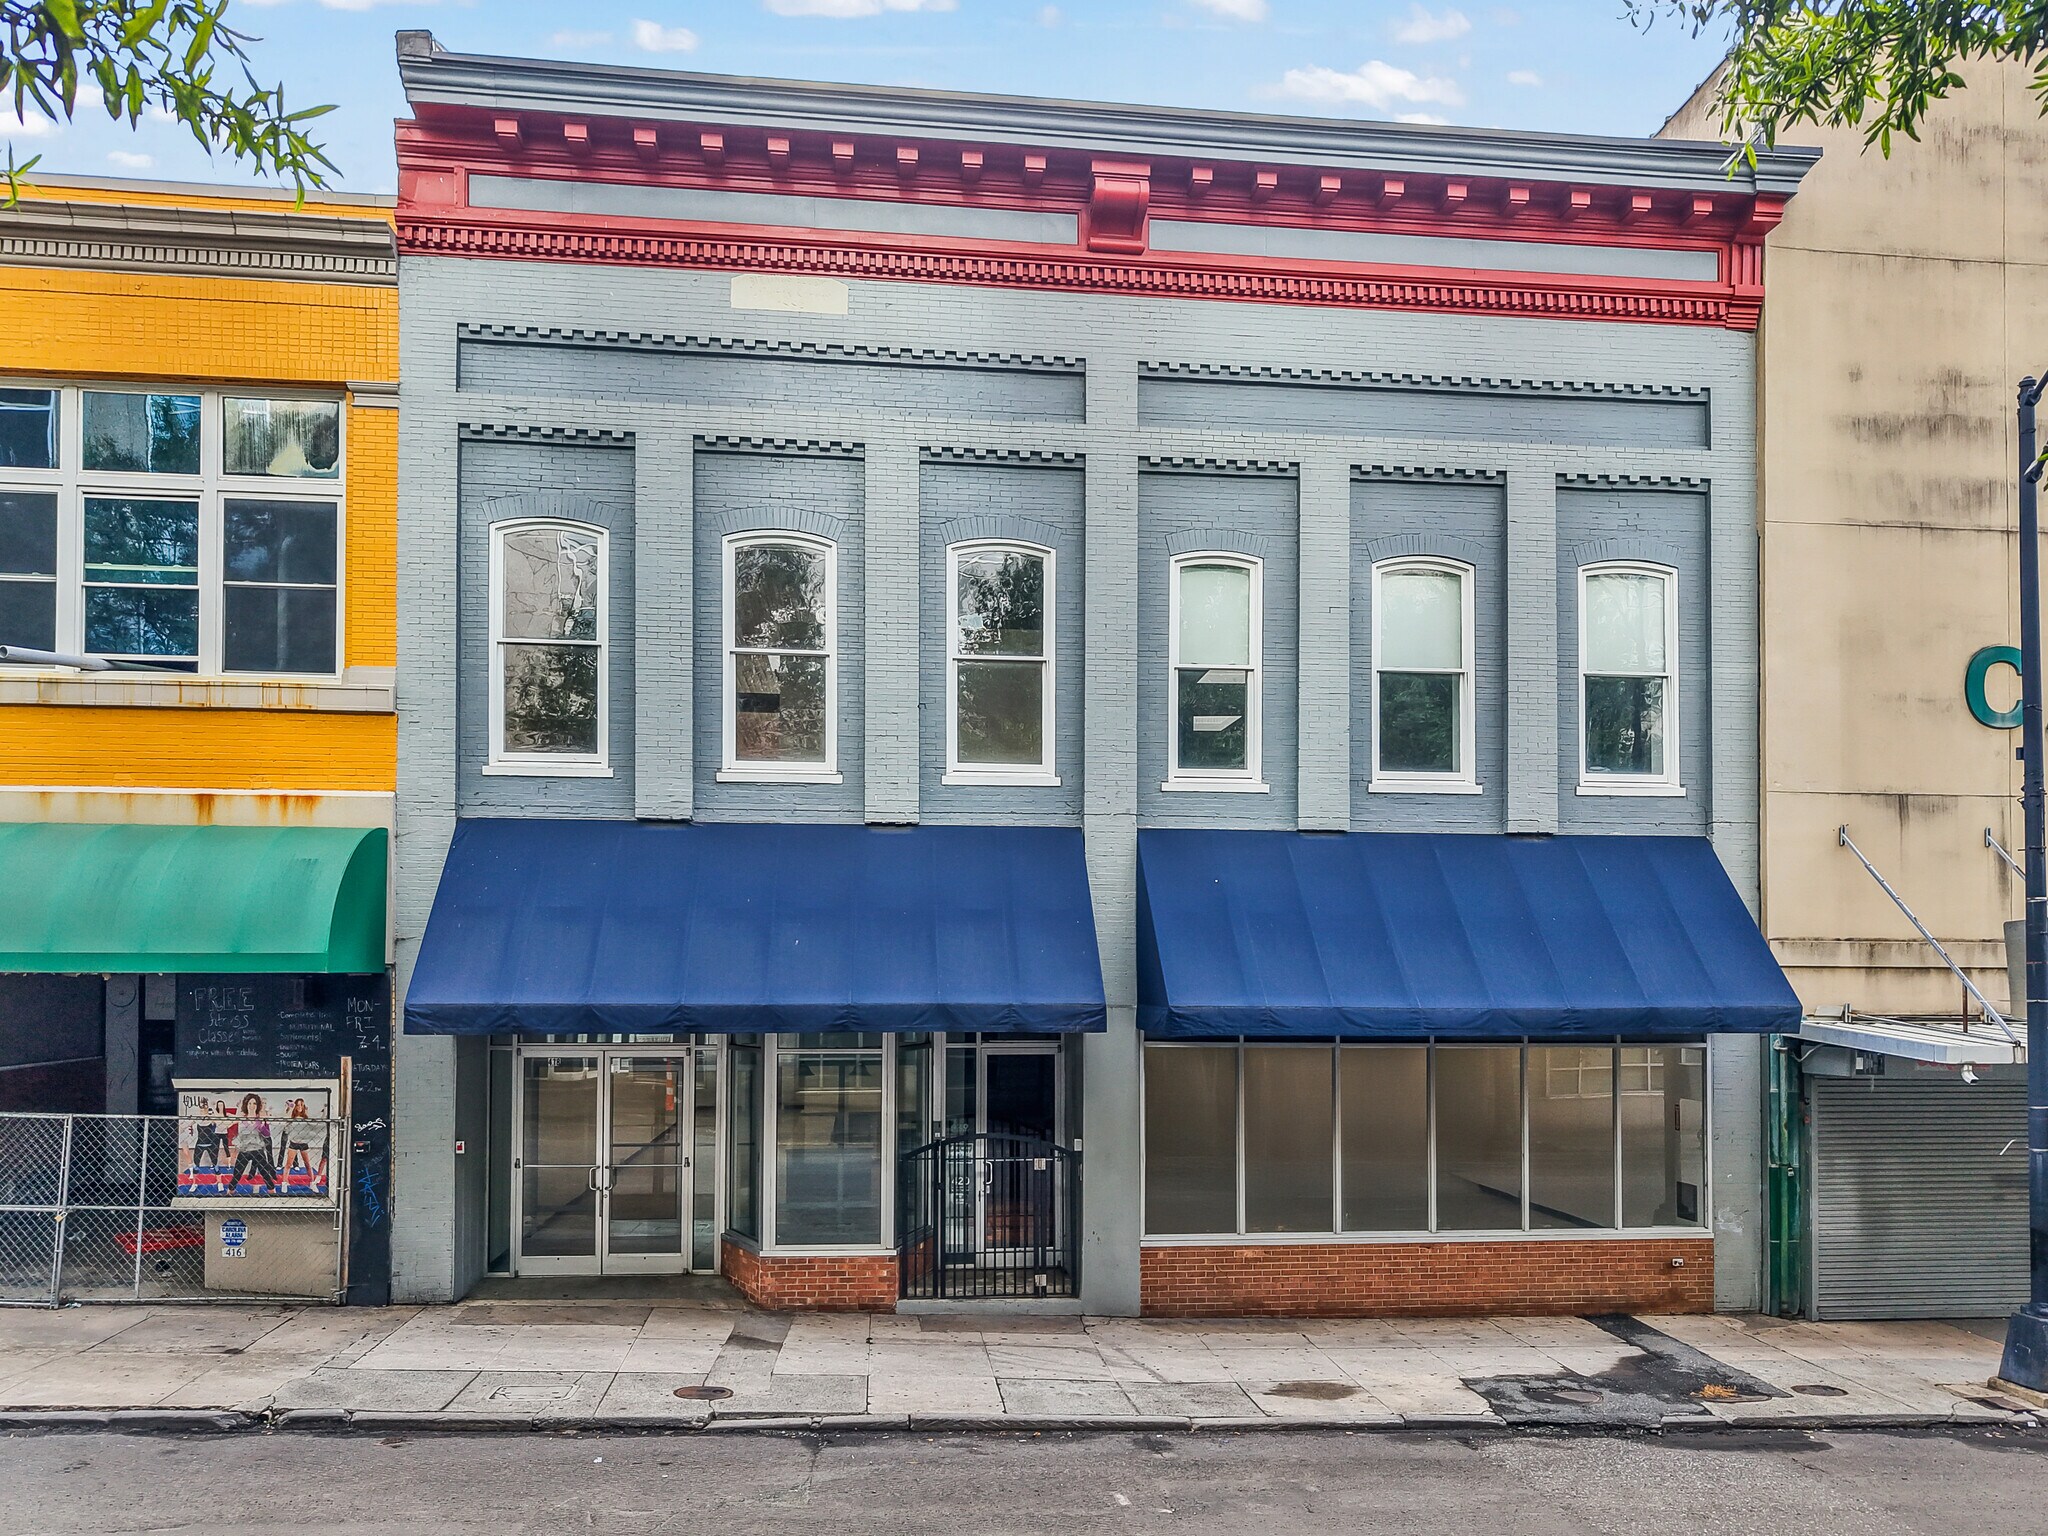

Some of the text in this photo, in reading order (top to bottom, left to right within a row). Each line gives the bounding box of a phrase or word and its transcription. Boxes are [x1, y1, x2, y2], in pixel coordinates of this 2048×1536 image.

[1964, 644, 2024, 730] C
[195, 987, 255, 1012] FREE
[352, 1064, 389, 1072] ATURDAYS
[225, 1248, 242, 1257] 416
